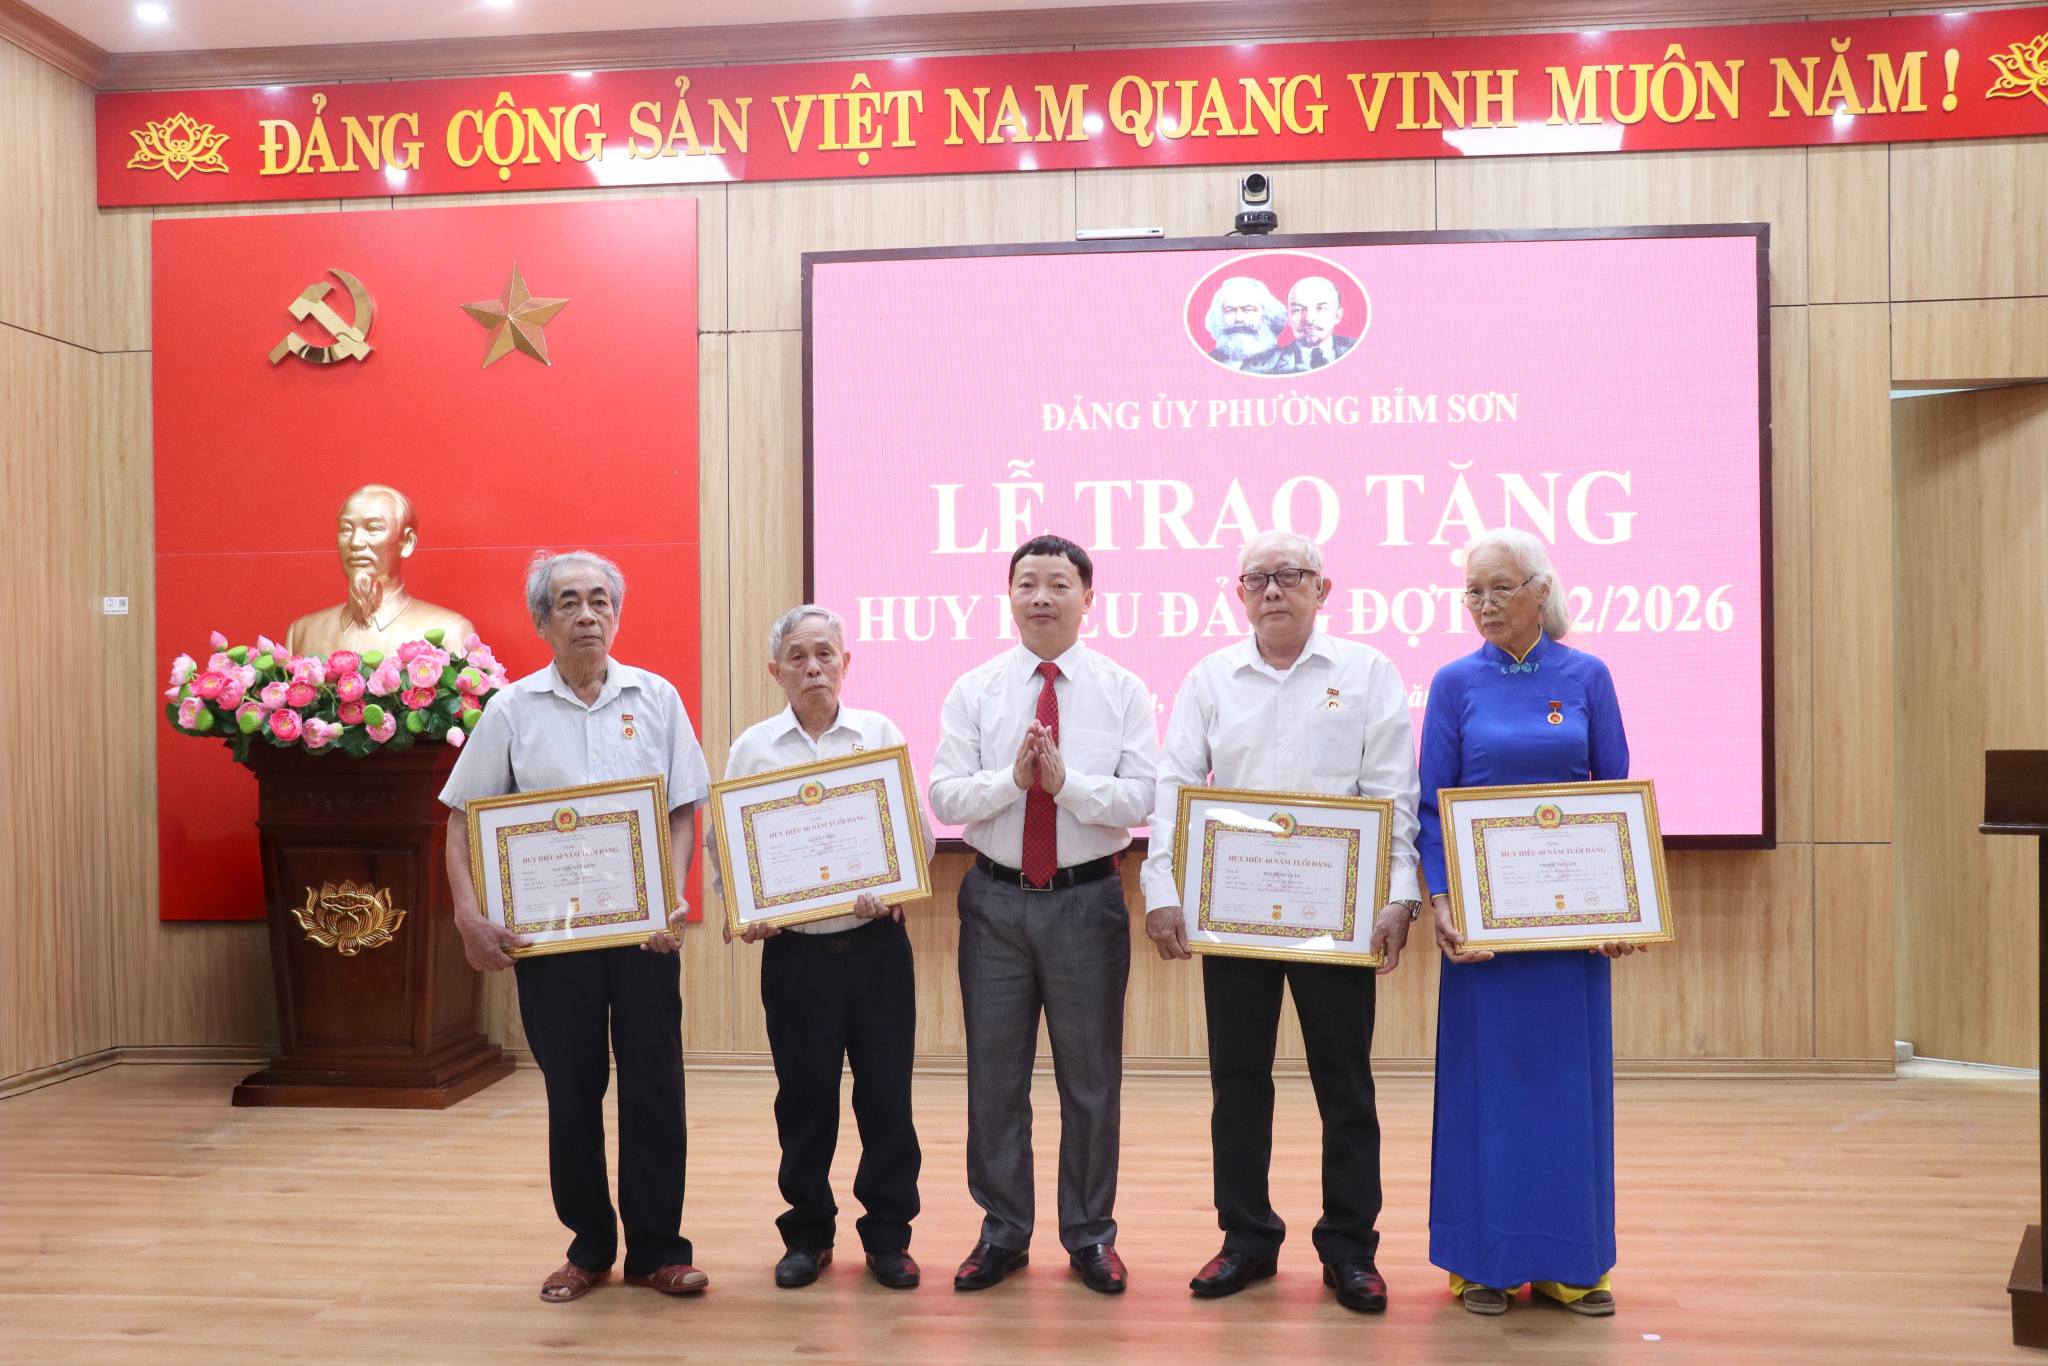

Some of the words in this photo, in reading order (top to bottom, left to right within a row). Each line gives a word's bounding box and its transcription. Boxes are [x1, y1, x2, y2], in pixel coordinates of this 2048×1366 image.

[259, 92, 425, 178] ĐẢNG
[446, 91, 607, 182] CỘNG
[628, 75, 753, 161] SẢN
[771, 73, 924, 166] VIỆT
[944, 83, 1090, 146] NAM
[1108, 74, 1329, 148] QUANG
[1348, 69, 1519, 131] VINH
[1545, 44, 1745, 126] MUÔN
[1041, 394, 1141, 431] ĐẢNG
[1150, 392, 1199, 429] ỦY
[1207, 389, 1362, 427] PHƯỜNG
[1370, 386, 1440, 425] BỈM
[1447, 393, 1519, 423] SƠN
[930, 458, 1050, 555] LỄ
[1074, 475, 1340, 552] TRAO
[1366, 459, 1639, 567] TẶNG
[855, 595, 981, 641] HUY
[1346, 584, 1468, 647] ĐỢT
